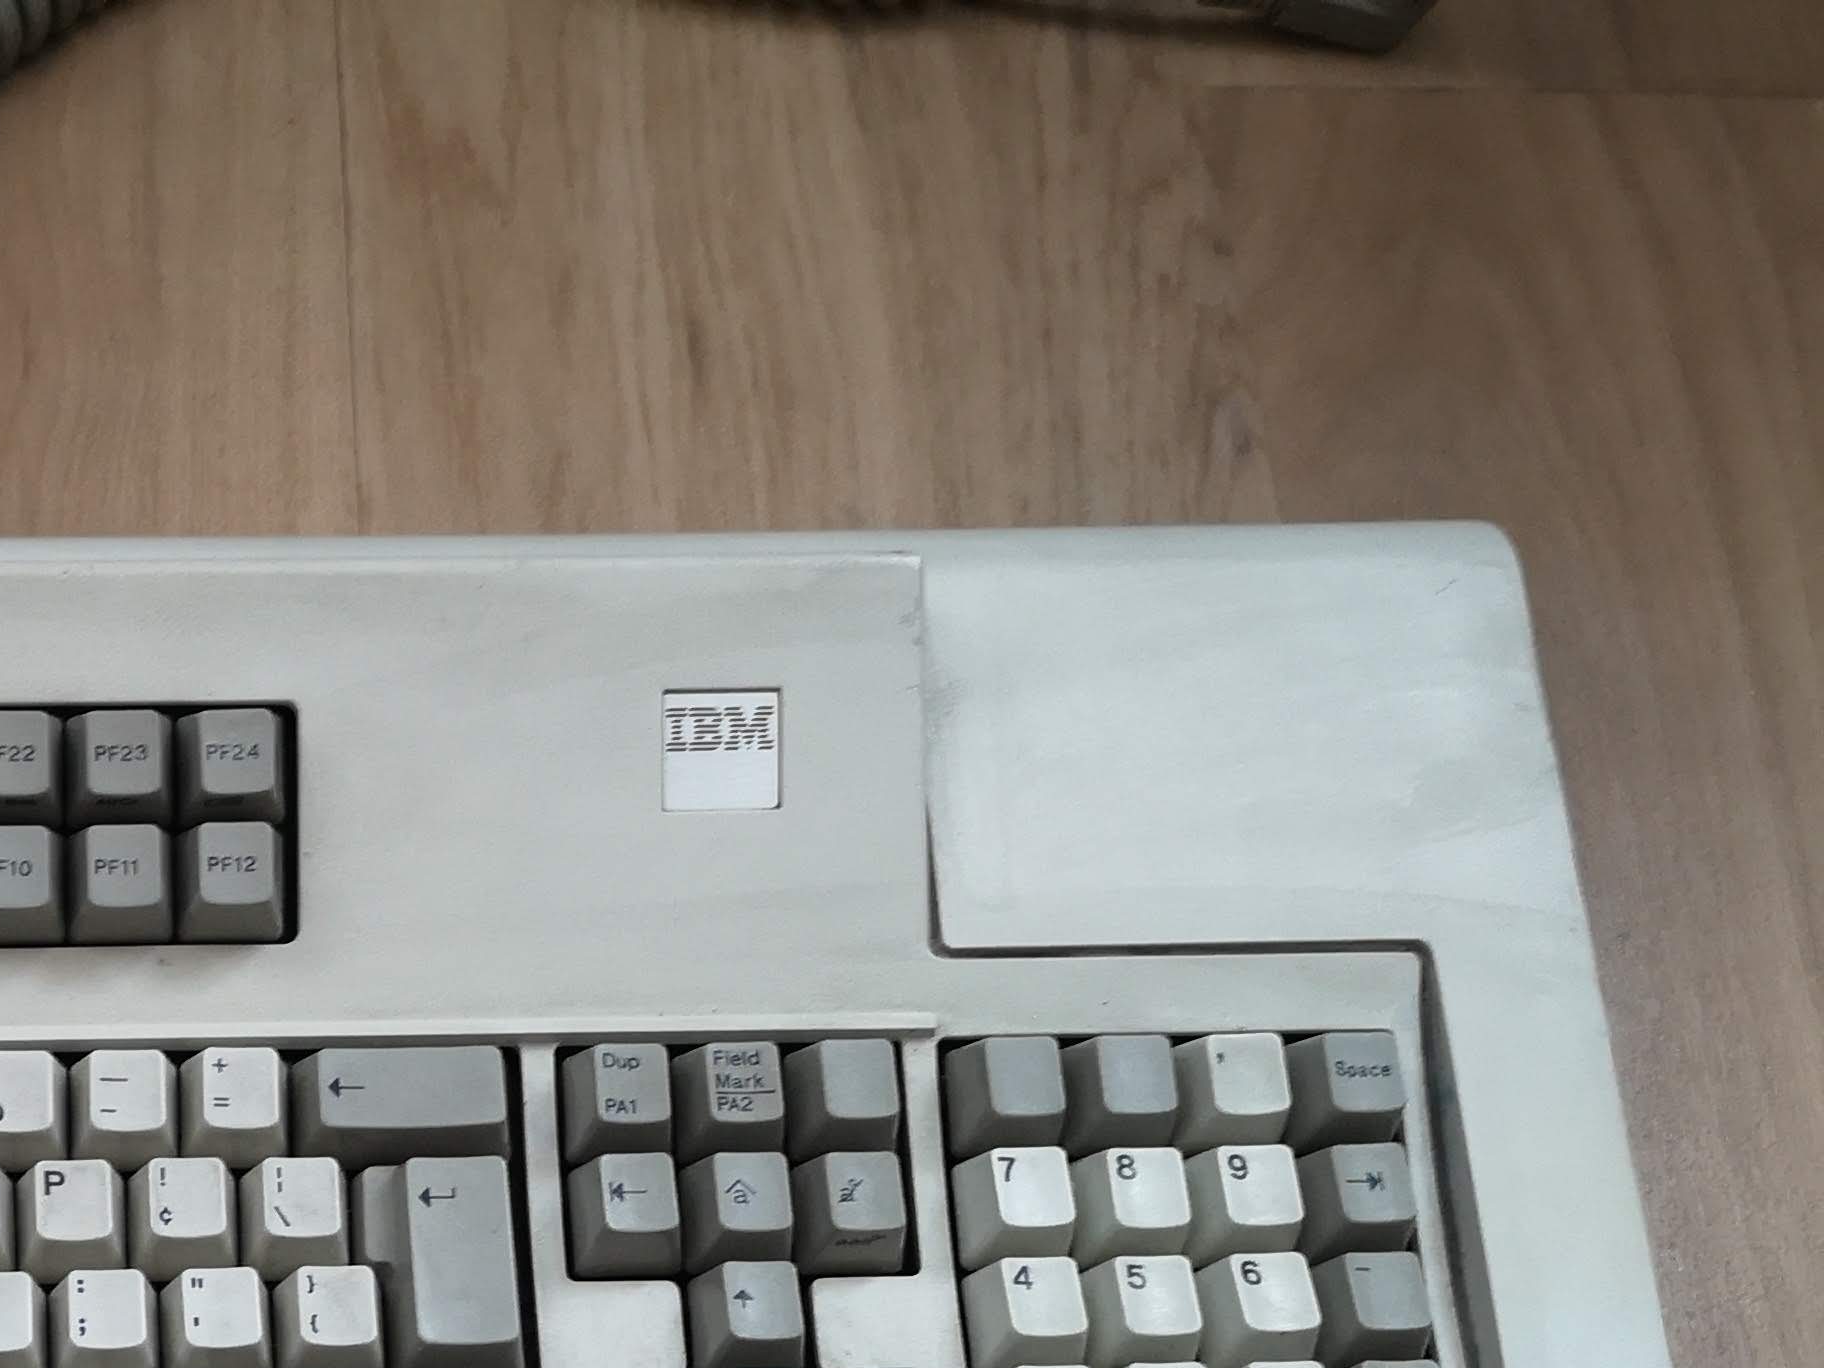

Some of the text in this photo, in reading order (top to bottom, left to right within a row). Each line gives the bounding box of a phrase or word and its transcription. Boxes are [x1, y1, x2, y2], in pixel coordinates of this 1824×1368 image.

[664, 705, 776, 753] IBM
[94, 743, 148, 762] PF23
[205, 743, 260, 761] PF24
[94, 858, 138, 876] PF11
[207, 855, 257, 873] PF12
[602, 1052, 641, 1072] Dup
[712, 1048, 761, 1068] Field
[1334, 1060, 1393, 1078] Space
[714, 1072, 767, 1090] Mark
[604, 1097, 637, 1114] PA1
[716, 1095, 754, 1113] PA2
[997, 1156, 1016, 1183] 7
[1115, 1153, 1137, 1180] 8
[1227, 1153, 1249, 1181] 9
[43, 1170, 66, 1196] P
[1013, 1265, 1033, 1290] 4
[1125, 1263, 1146, 1290] 5
[1240, 1260, 1262, 1286] 6
